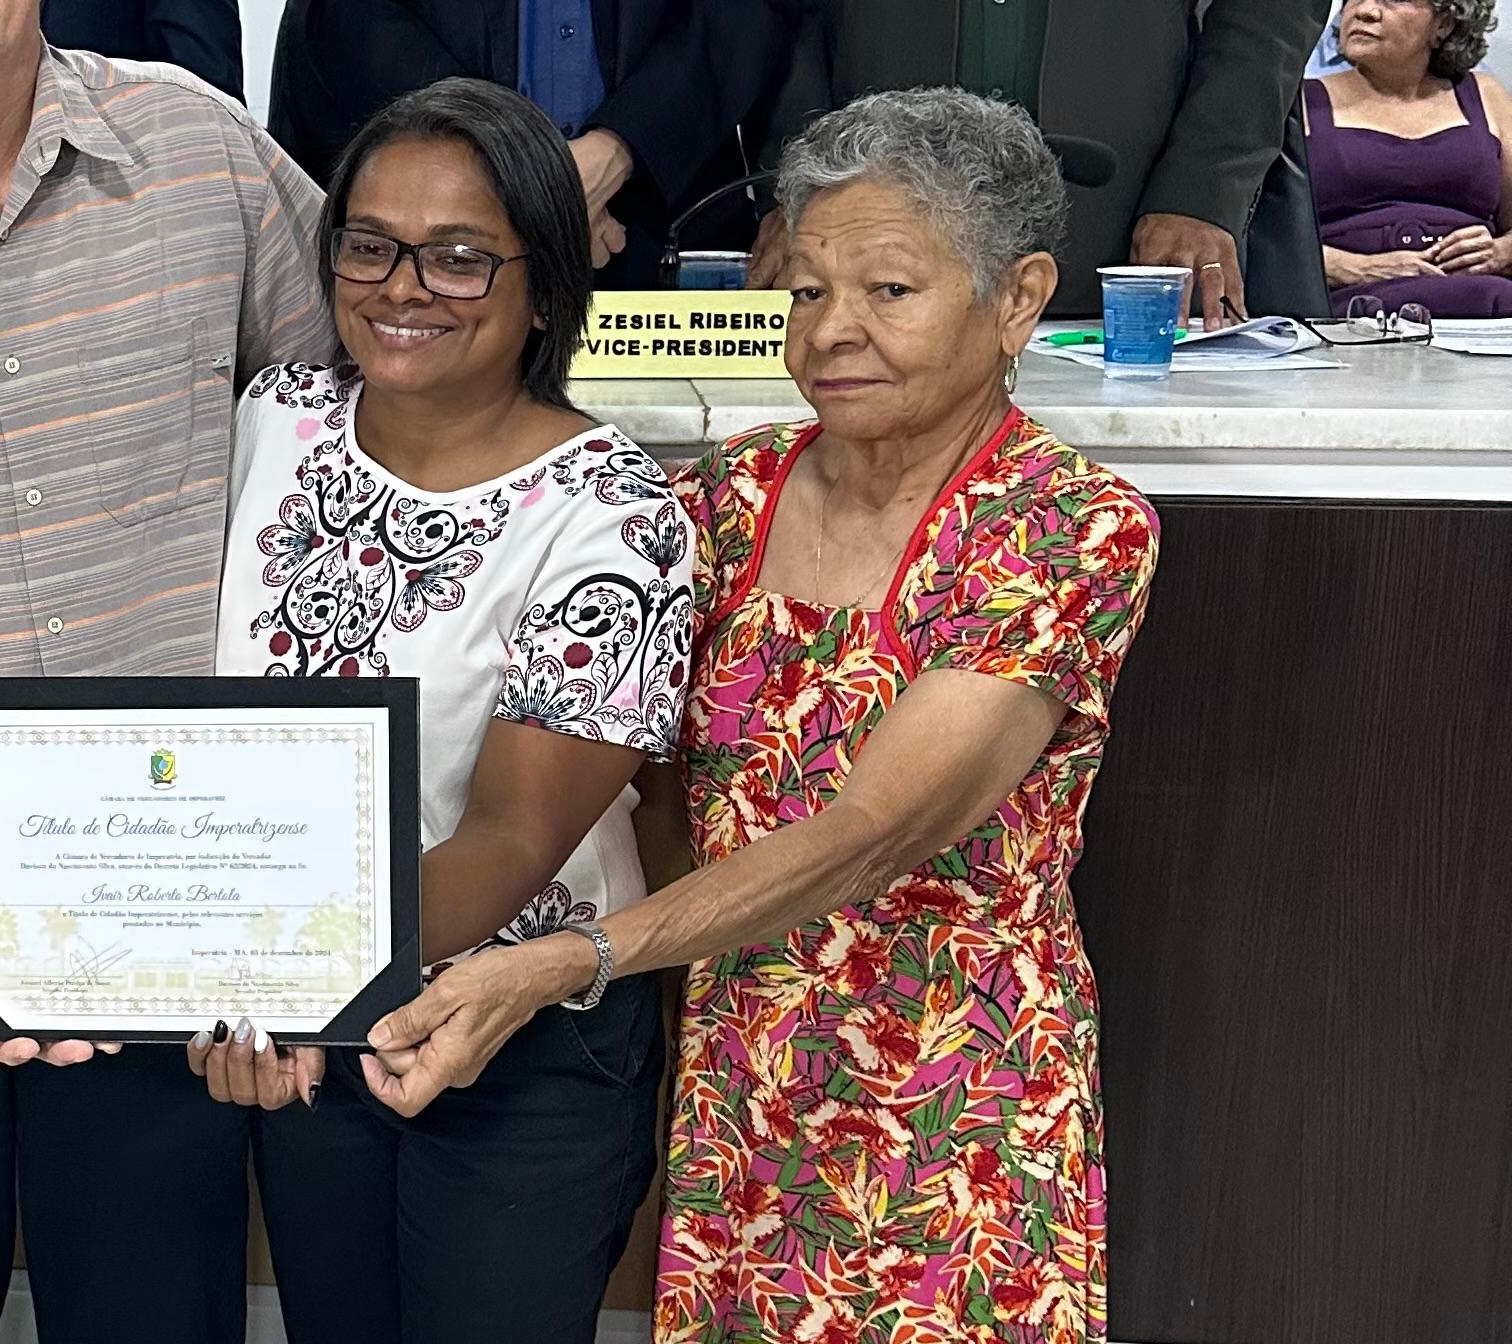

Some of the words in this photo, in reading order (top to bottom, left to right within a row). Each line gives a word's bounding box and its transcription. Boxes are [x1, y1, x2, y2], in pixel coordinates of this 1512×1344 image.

[598, 313, 682, 330] ZESIEL
[689, 312, 785, 330] RIBEIRO
[586, 339, 783, 357] VICE-PRESIDENT
[82, 817, 101, 835] de
[106, 812, 177, 838] Cidadão
[180, 811, 308, 842] Imperatrizense
[126, 884, 182, 902] Roberto
